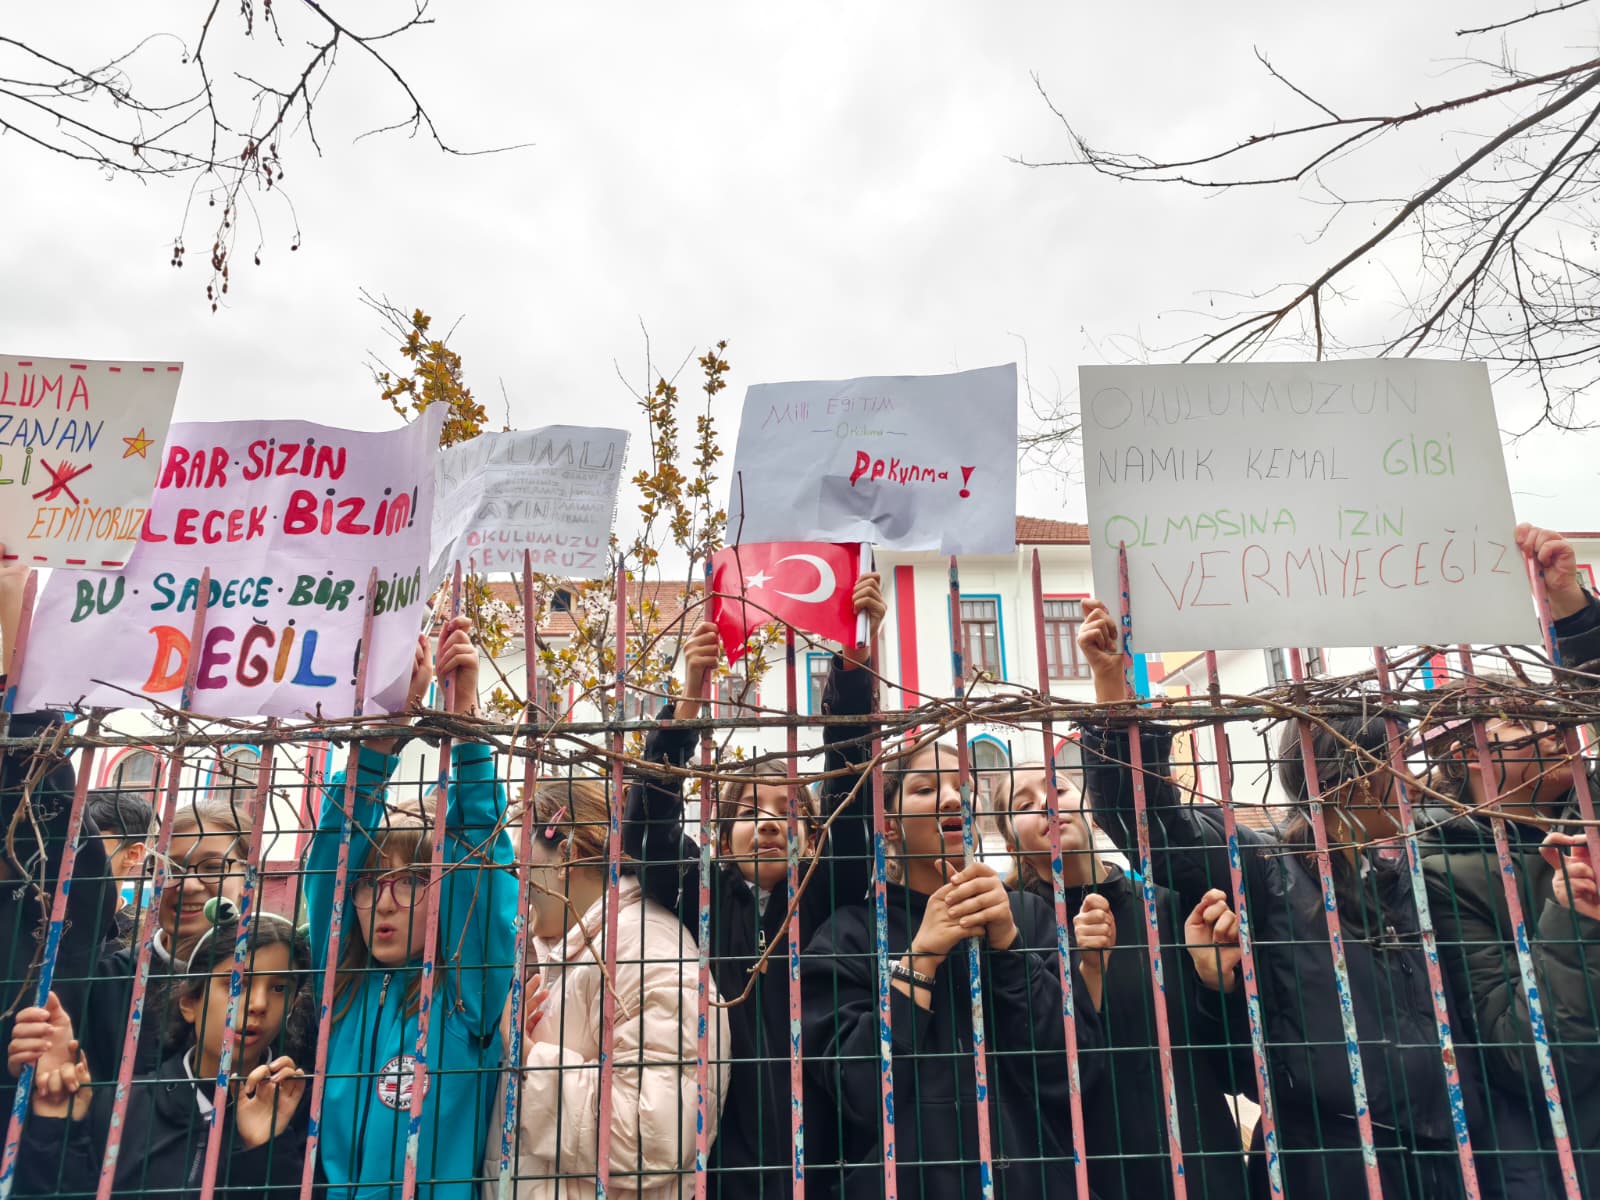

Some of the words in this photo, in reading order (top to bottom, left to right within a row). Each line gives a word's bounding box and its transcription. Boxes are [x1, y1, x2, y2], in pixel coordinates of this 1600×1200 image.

[1090, 377, 1417, 430] OKULUMUZUN
[155, 445, 230, 489] RAR
[242, 437, 347, 481] SİZİN
[1098, 445, 1214, 488] NAMIK
[1246, 447, 1350, 481] KEMAL
[1382, 432, 1455, 476] GİBİ
[27, 497, 146, 543] ETMİYORUZ
[140, 505, 268, 545] LECEK
[1104, 507, 1297, 549] OLMASINA
[70, 575, 126, 623] BU
[150, 572, 274, 613] SADECE
[287, 570, 356, 611] BİR
[373, 565, 422, 617] BİNA
[142, 616, 338, 694] DEĞİL
